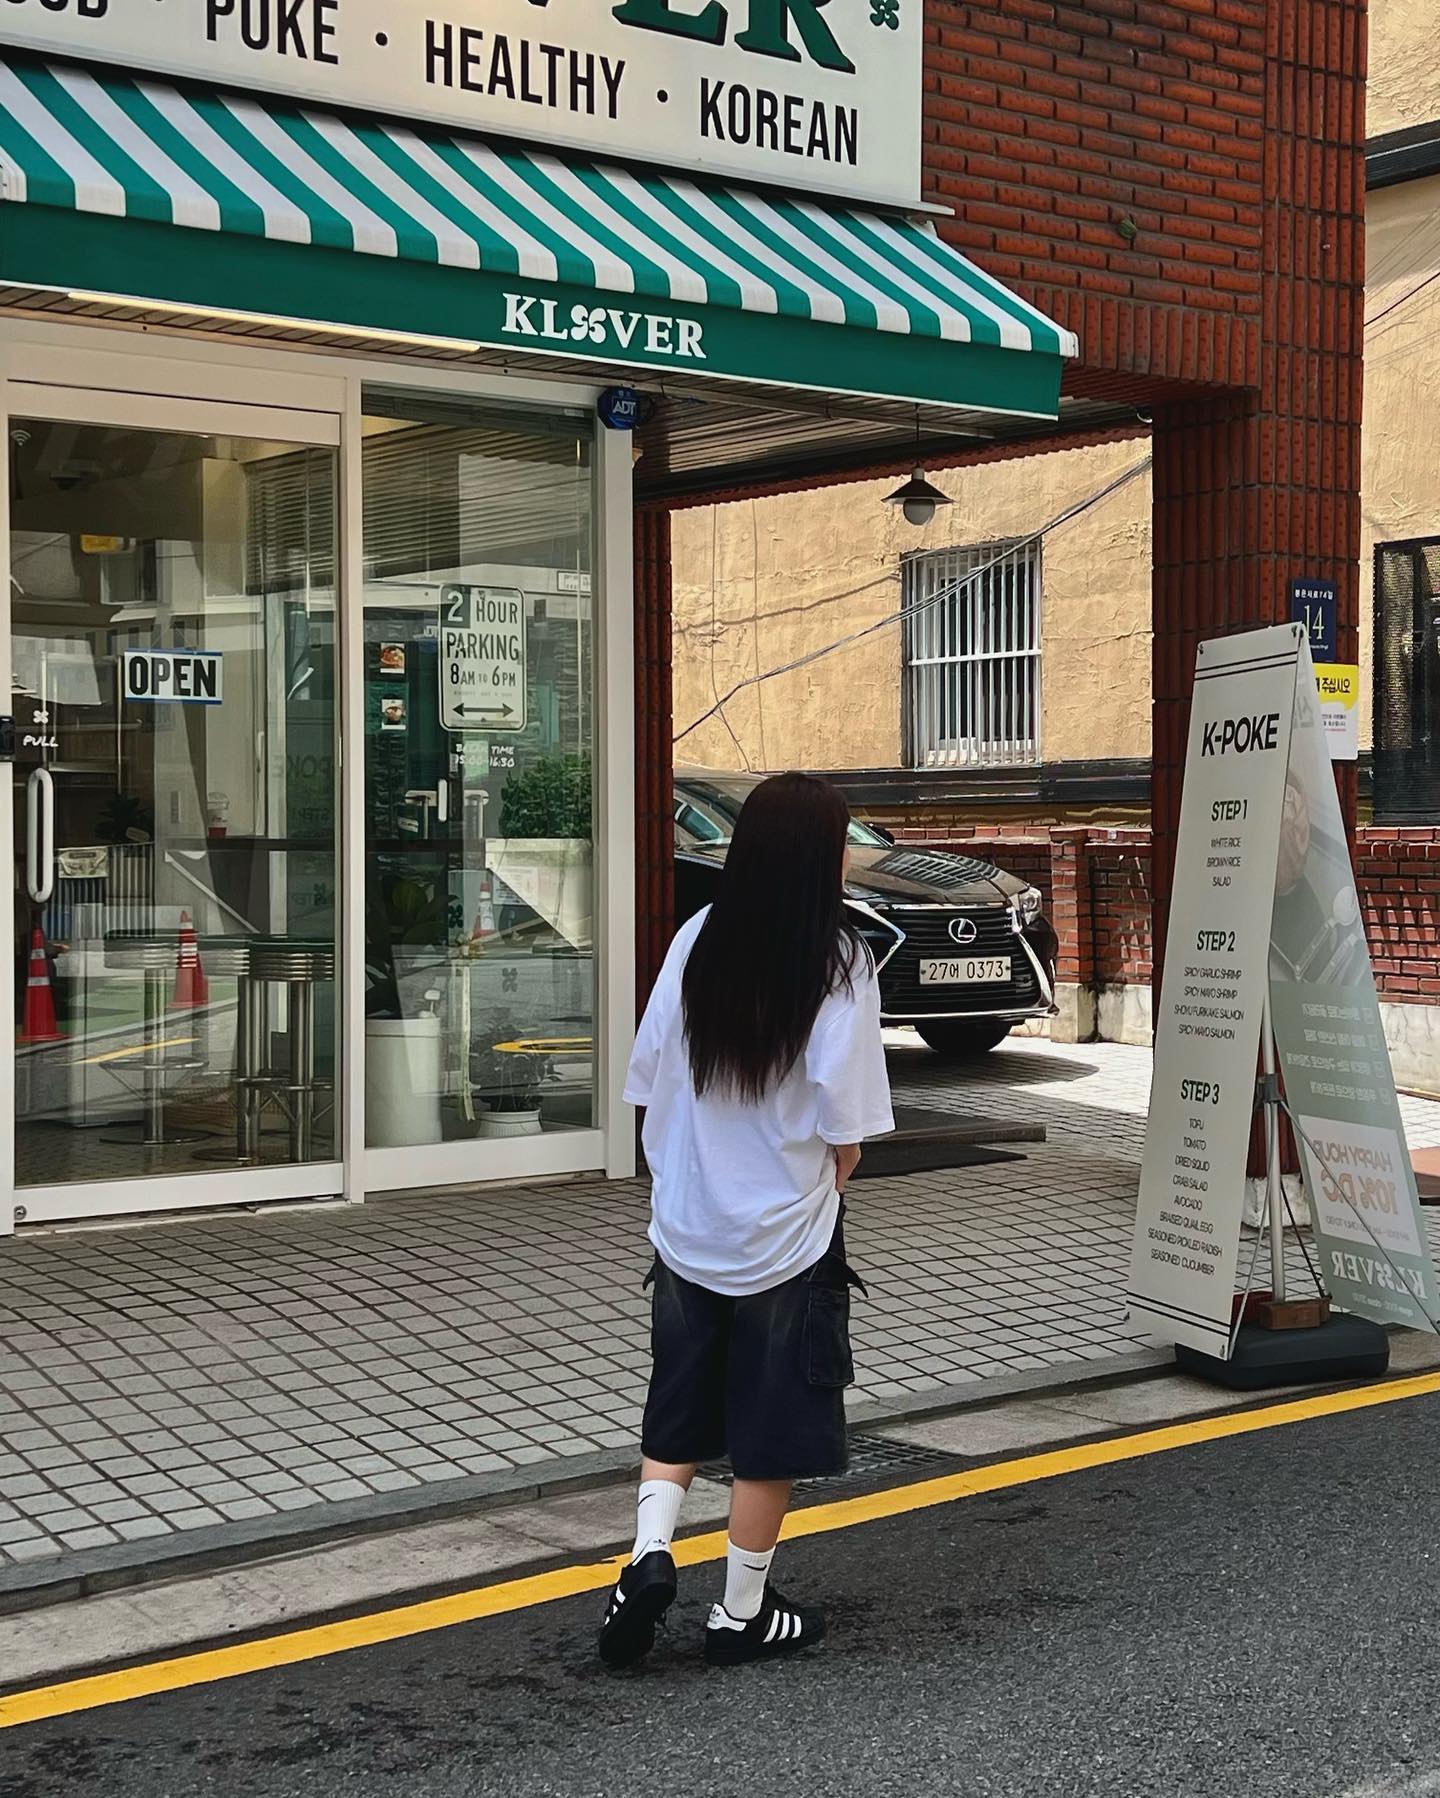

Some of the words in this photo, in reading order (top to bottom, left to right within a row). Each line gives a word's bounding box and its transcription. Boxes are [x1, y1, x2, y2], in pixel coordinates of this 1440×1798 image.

[206, 0, 339, 65] POKE
[425, 19, 626, 119] HEALTHY
[700, 76, 858, 166] KOREAN
[612, 400, 636, 416] ADT
[447, 590, 464, 622] 2
[476, 600, 518, 624] HOUR
[1304, 604, 1325, 640] 14
[446, 632, 519, 661] PARKING
[129, 655, 217, 697] OPEN
[22, 734, 59, 748] PULL
[1201, 713, 1280, 757] K-POKE
[491, 745, 515, 755] TIME
[1211, 800, 1241, 822] STEP
[1243, 799, 1248, 820] 1
[1196, 930, 1227, 951] STEP
[1227, 931, 1236, 952] 2
[966, 960, 1004, 979] 0373
[1180, 1078, 1211, 1102] STEP
[1211, 1083, 1220, 1105] 3
